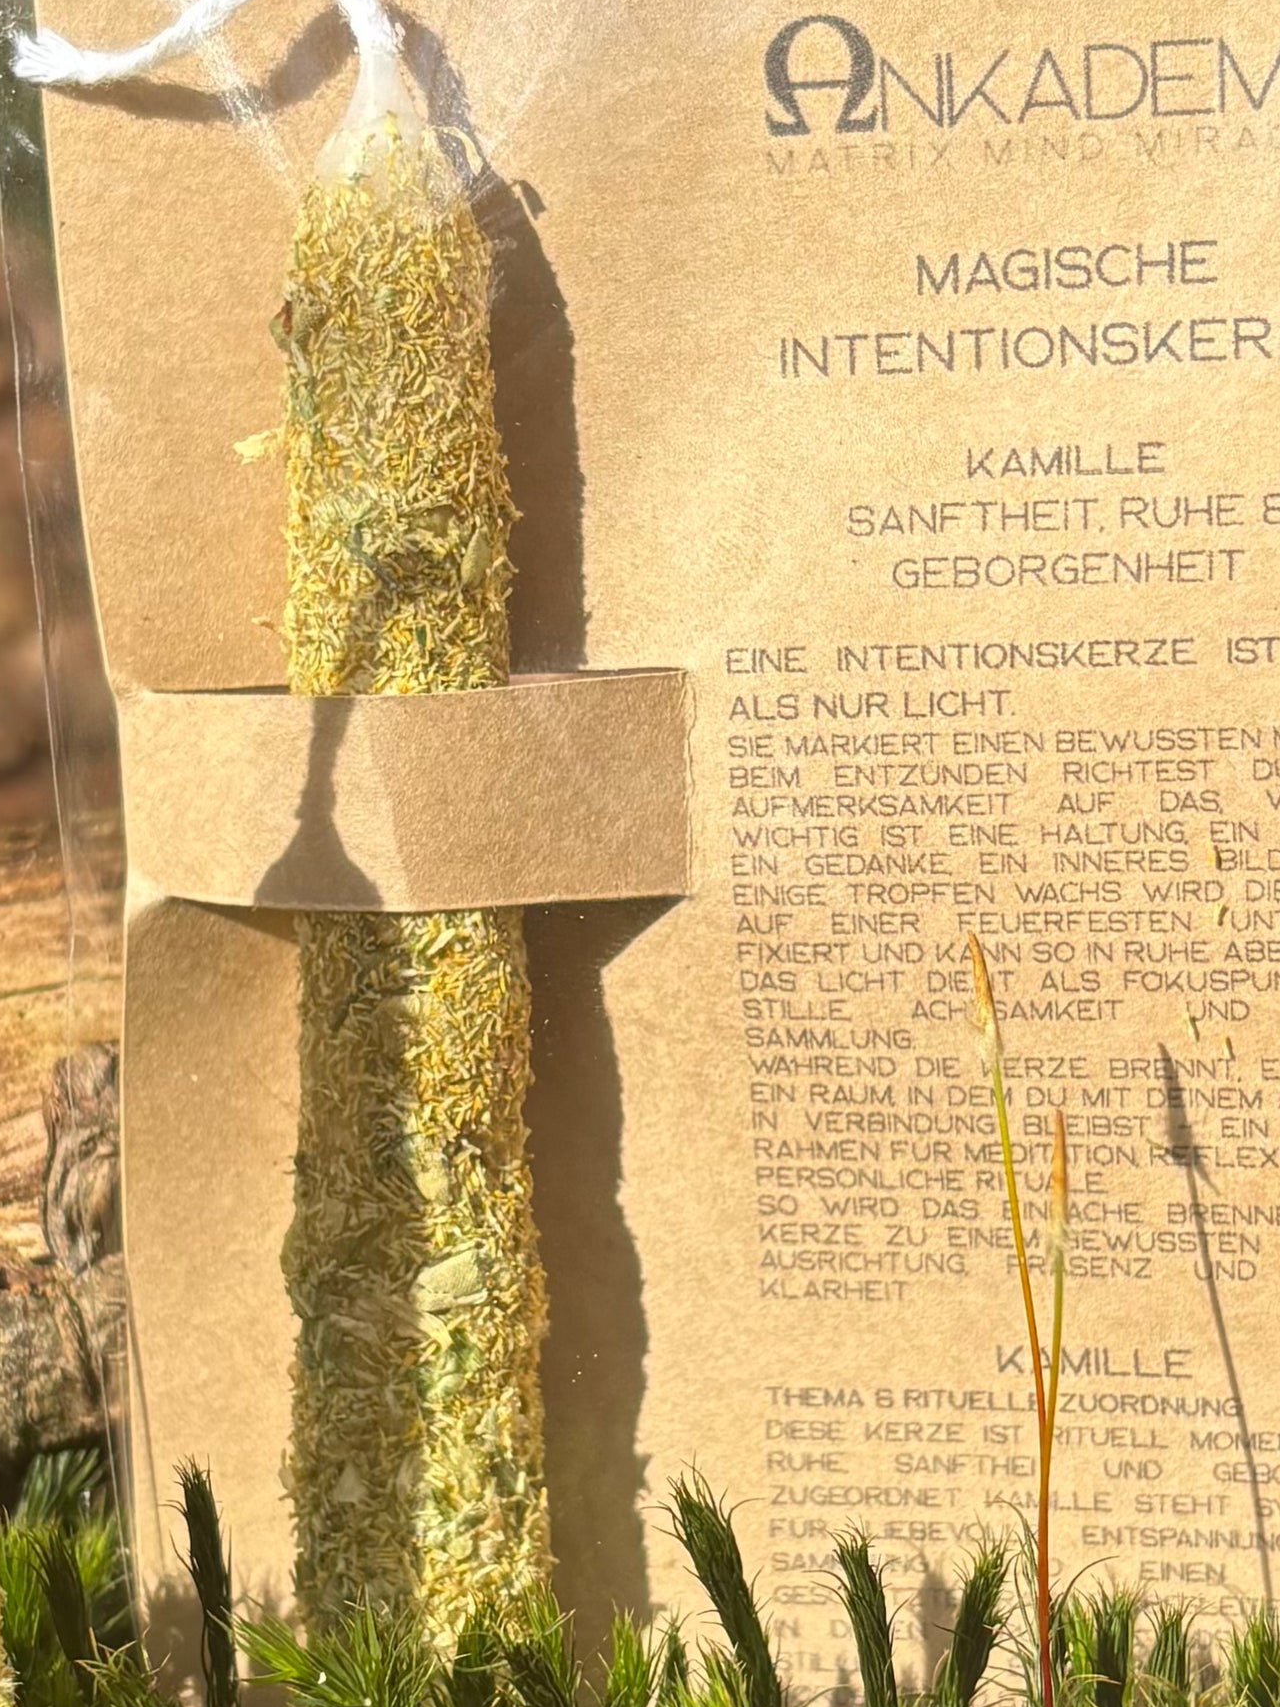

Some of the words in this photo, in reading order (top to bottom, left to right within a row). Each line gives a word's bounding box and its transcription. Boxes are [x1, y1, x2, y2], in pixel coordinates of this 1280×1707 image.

[767, 143, 956, 174] MATRIX
[984, 130, 1104, 165] MIND
[917, 240, 1218, 295] MAGISCHE
[967, 442, 1166, 478] KAMILLE
[1121, 494, 1245, 529] RUHE
[892, 549, 1246, 590] GEBORGENHEIT
[726, 646, 807, 673] EINE
[837, 638, 1197, 672] INTENTIONSKERZE
[1227, 636, 1280, 664] IST
[729, 694, 799, 721] ALS
[813, 692, 889, 719] NUR
[904, 690, 1016, 718] LICHT.
[728, 735, 773, 758] SIE
[785, 733, 939, 757] MARKIERT
[953, 731, 1044, 755] EINEN
[1057, 727, 1261, 754] BEWUSSTEN
[728, 765, 800, 789] BEIM
[1063, 759, 1216, 784] RICHTEST
[732, 793, 1010, 819] AUFMERKSAMKEIT
[1057, 792, 1115, 814] AUF
[732, 825, 858, 849] WICHTIG
[881, 825, 923, 848] IST
[949, 824, 1019, 847] EINE
[1210, 820, 1260, 844] EIN
[731, 854, 779, 877] EIN
[979, 852, 1028, 875] EIN
[1054, 850, 1189, 873] INNERES
[734, 884, 826, 907] EINIGE
[848, 882, 995, 905] TROPFEN
[1015, 881, 1122, 904] WACHS
[1143, 880, 1225, 903] WIRD
[736, 913, 794, 937] AUF
[832, 912, 921, 936] EINER
[958, 910, 1193, 935] FEUERFESTEN
[737, 943, 851, 966] FIXIERT
[862, 942, 924, 965] UND
[937, 942, 1021, 965] KANN
[1032, 941, 1076, 965] SO
[1088, 941, 1113, 964] IN
[1124, 940, 1210, 964] RUHE
[740, 971, 797, 994] DAS
[819, 971, 905, 994] LICHT
[1041, 969, 1101, 993] ALS
[911, 999, 1124, 1022] ACHSAMKEIT
[1187, 999, 1250, 1022] UND
[915, 1056, 961, 1079] DIE
[750, 1082, 795, 1104] EIN
[908, 1085, 934, 1107] IN
[948, 1085, 1012, 1108] DEM
[1026, 1086, 1067, 1108] DU
[1082, 1087, 1131, 1109] MIT
[1147, 1087, 1263, 1110] DEINEM
[752, 1110, 778, 1131] IN
[804, 1111, 995, 1136] VERBINDUNG
[1024, 1113, 1152, 1138] BLEIBST
[1220, 1117, 1269, 1139] EIN
[753, 1139, 879, 1163] RAHMEN
[965, 1142, 1138, 1167] MEDITTION,
[757, 1194, 799, 1216] SO
[821, 1196, 900, 1218] WIRD
[922, 1198, 979, 1220] DAS
[1002, 1200, 1143, 1224] EINACHE
[757, 1223, 862, 1246] KERZE
[885, 1224, 927, 1247] ZU
[1194, 1260, 1257, 1282] UND
[760, 1278, 909, 1301] KLARHEIT
[765, 1386, 865, 1410] THEMA
[766, 1420, 847, 1442] DIESE
[864, 1421, 966, 1444] KERZE
[983, 1424, 1023, 1445] IST
[894, 1452, 1040, 1479] SANFTHEI
[1104, 1458, 1163, 1481] UND
[1134, 1493, 1232, 1516] STEHT
[1138, 1560, 1227, 1585] EINEN
